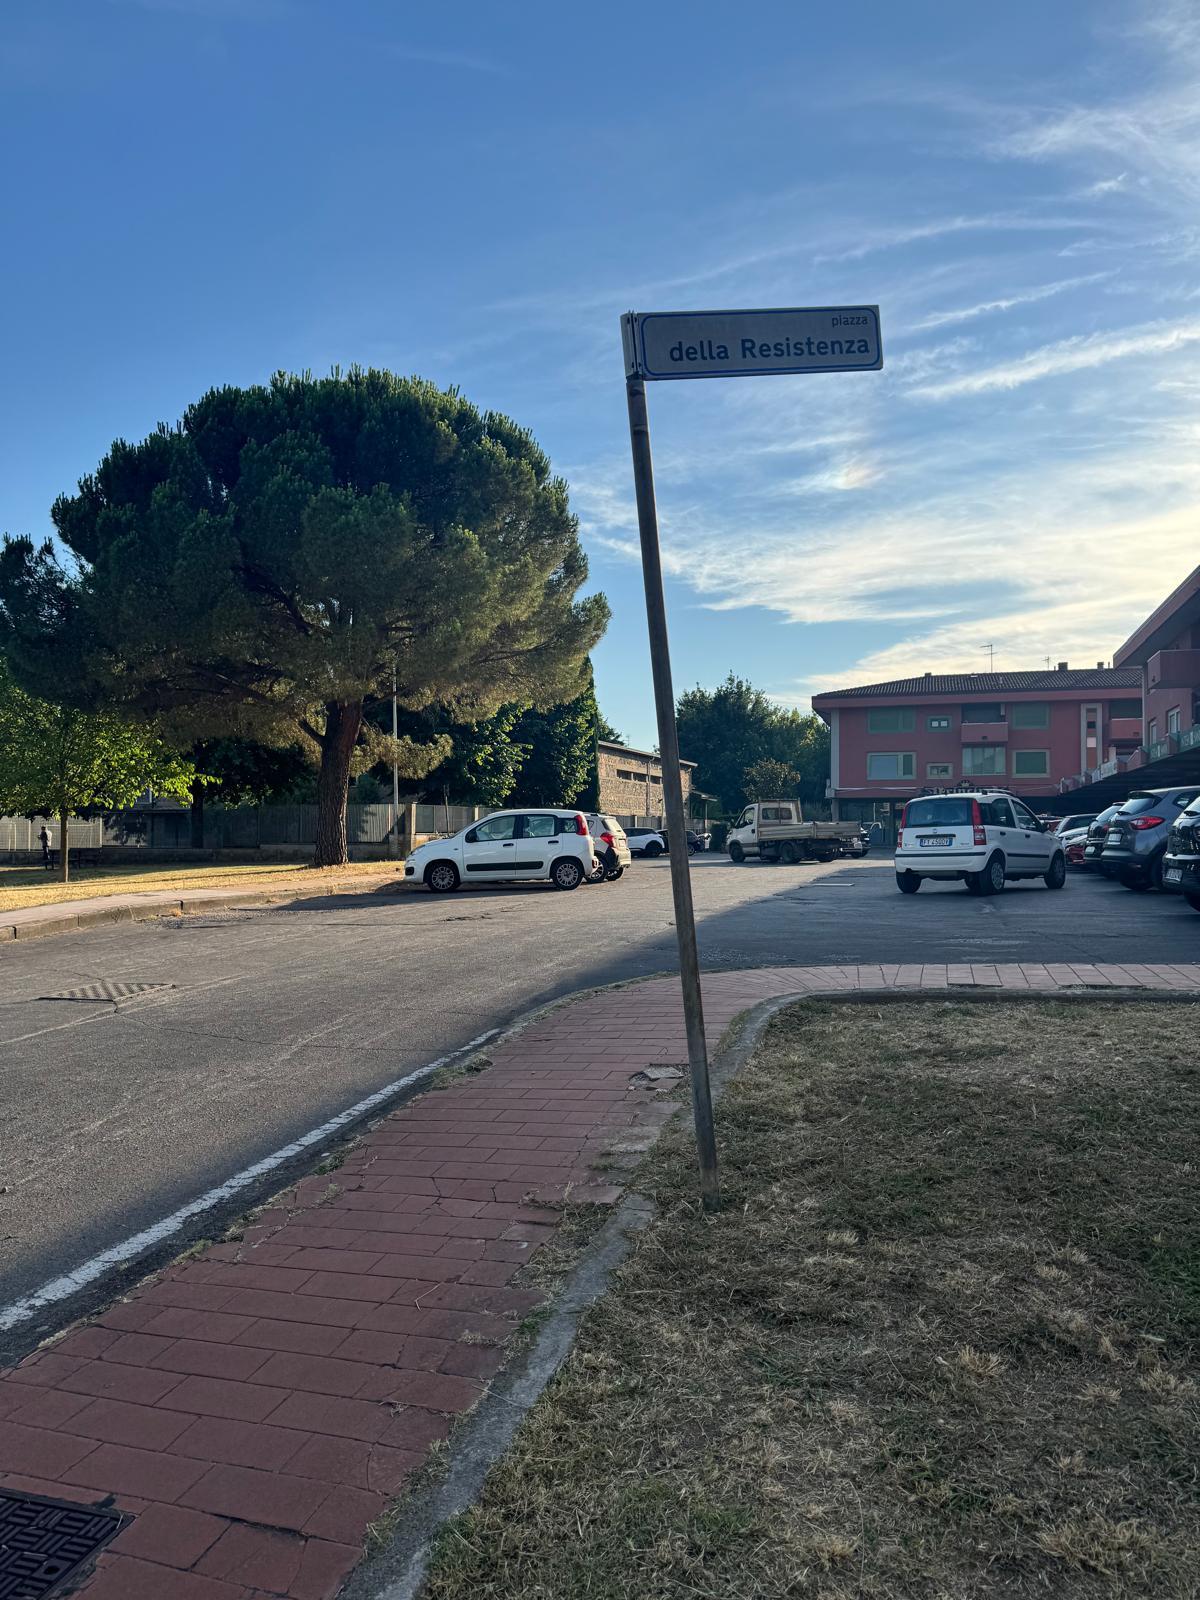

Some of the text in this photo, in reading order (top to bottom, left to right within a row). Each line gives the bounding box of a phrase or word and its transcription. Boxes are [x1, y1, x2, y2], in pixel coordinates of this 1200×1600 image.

[832, 315, 868, 328] piazza
[669, 337, 870, 362] della Resistenza
